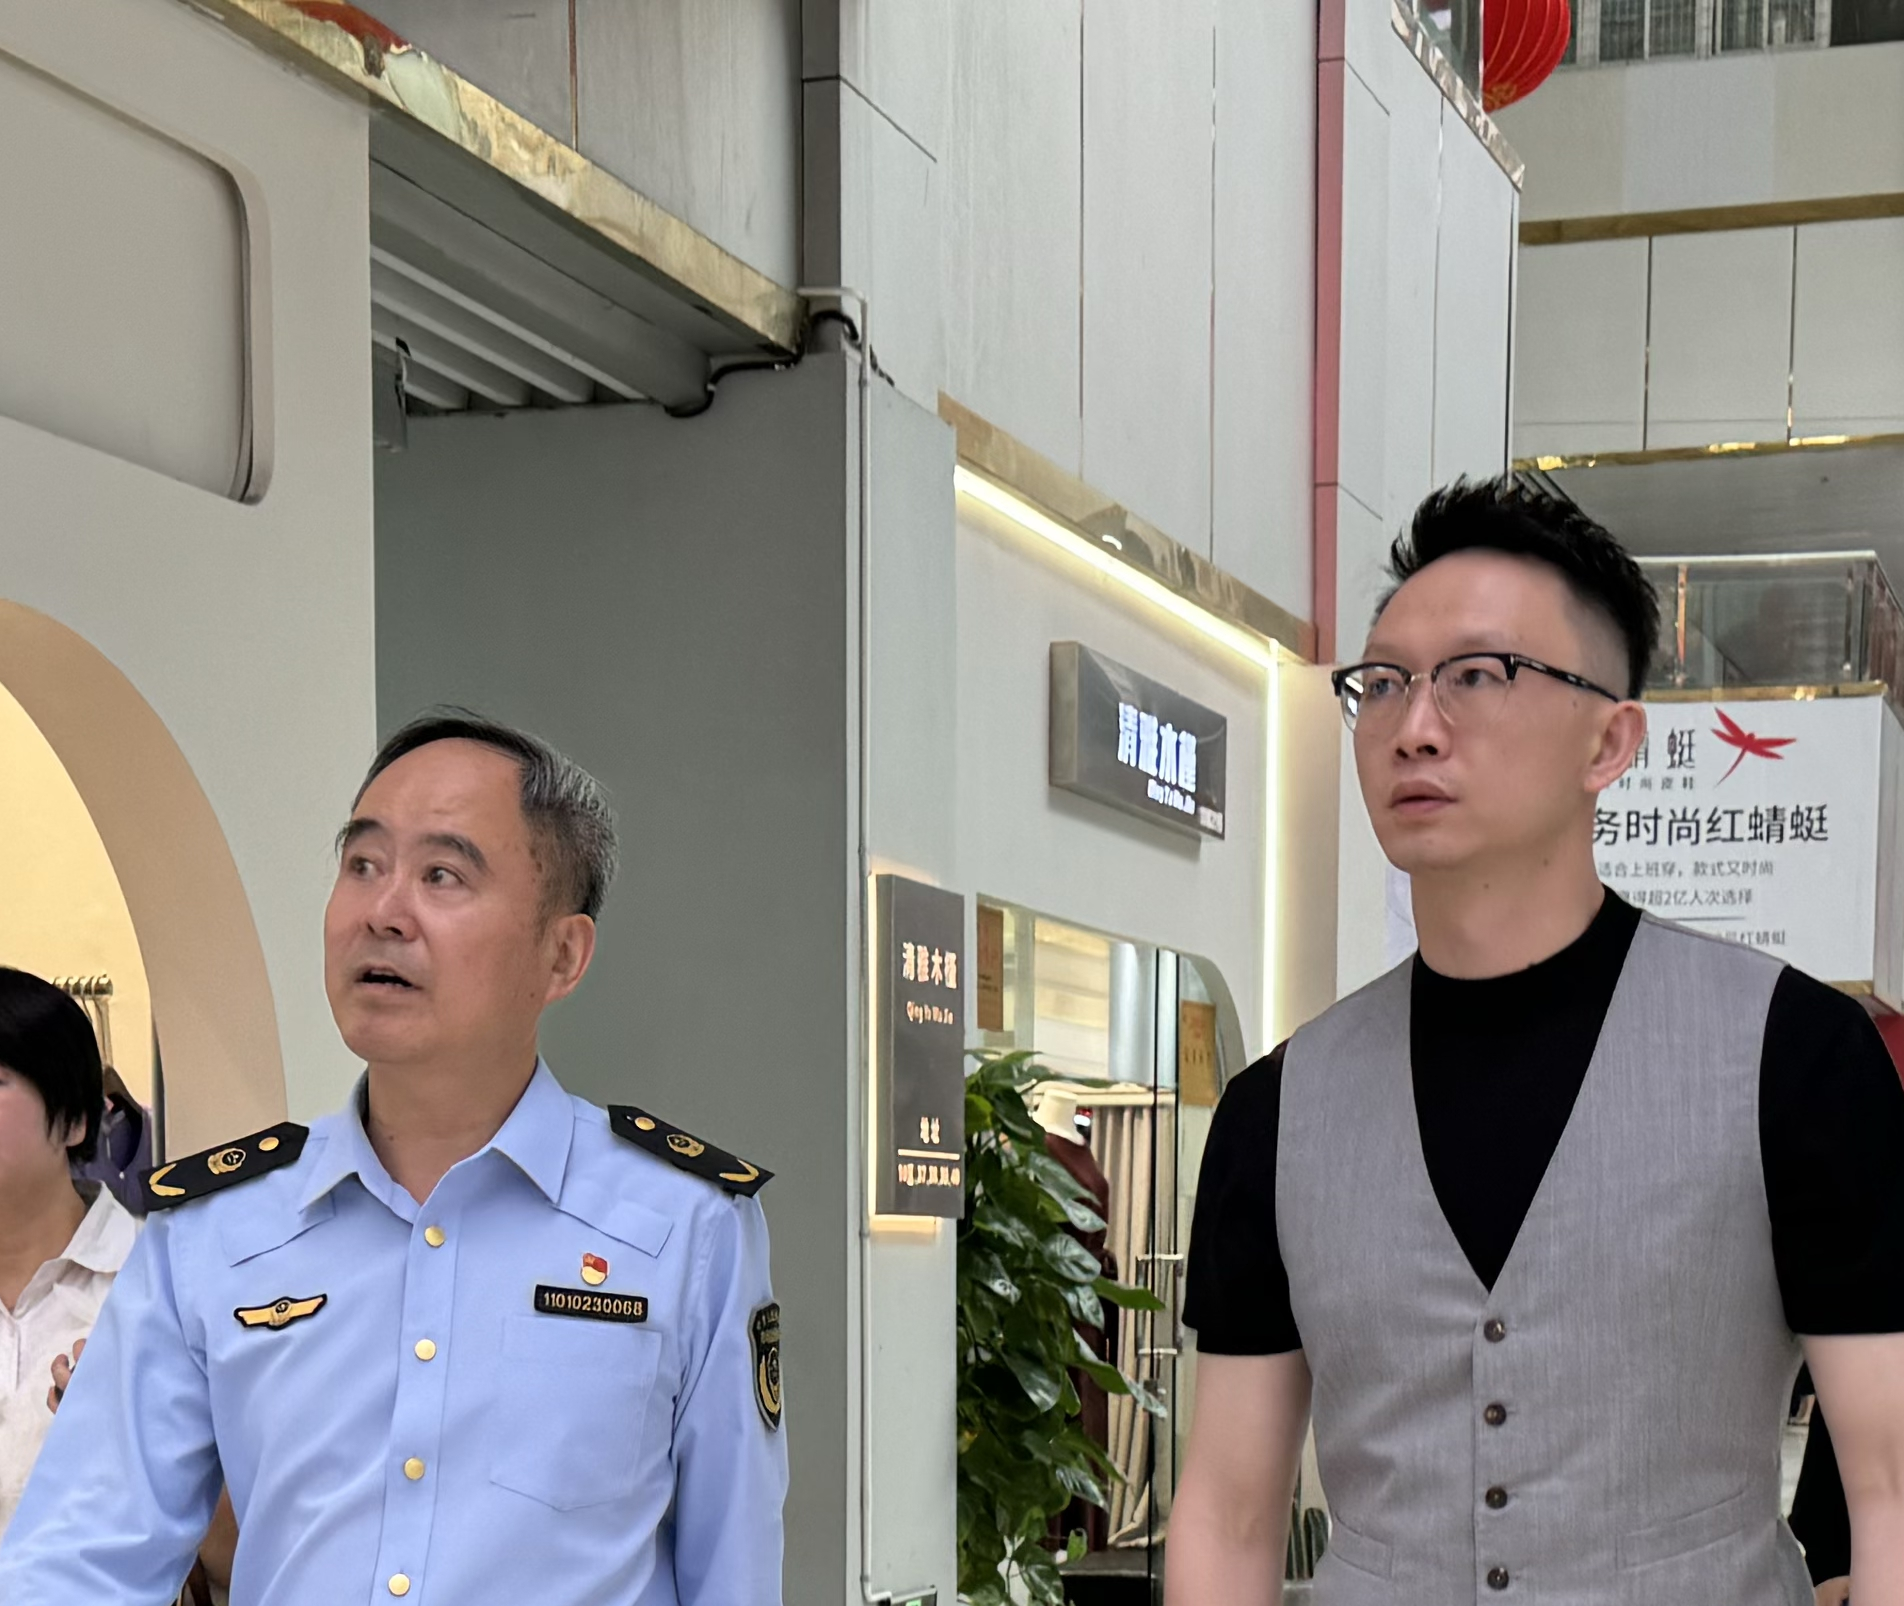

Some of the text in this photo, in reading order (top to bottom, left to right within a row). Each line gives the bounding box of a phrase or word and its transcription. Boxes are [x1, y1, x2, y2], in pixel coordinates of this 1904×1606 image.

[1592, 803, 1829, 847] 务时尚红蜻蜓
[543, 1292, 644, 1317] 11010230068
